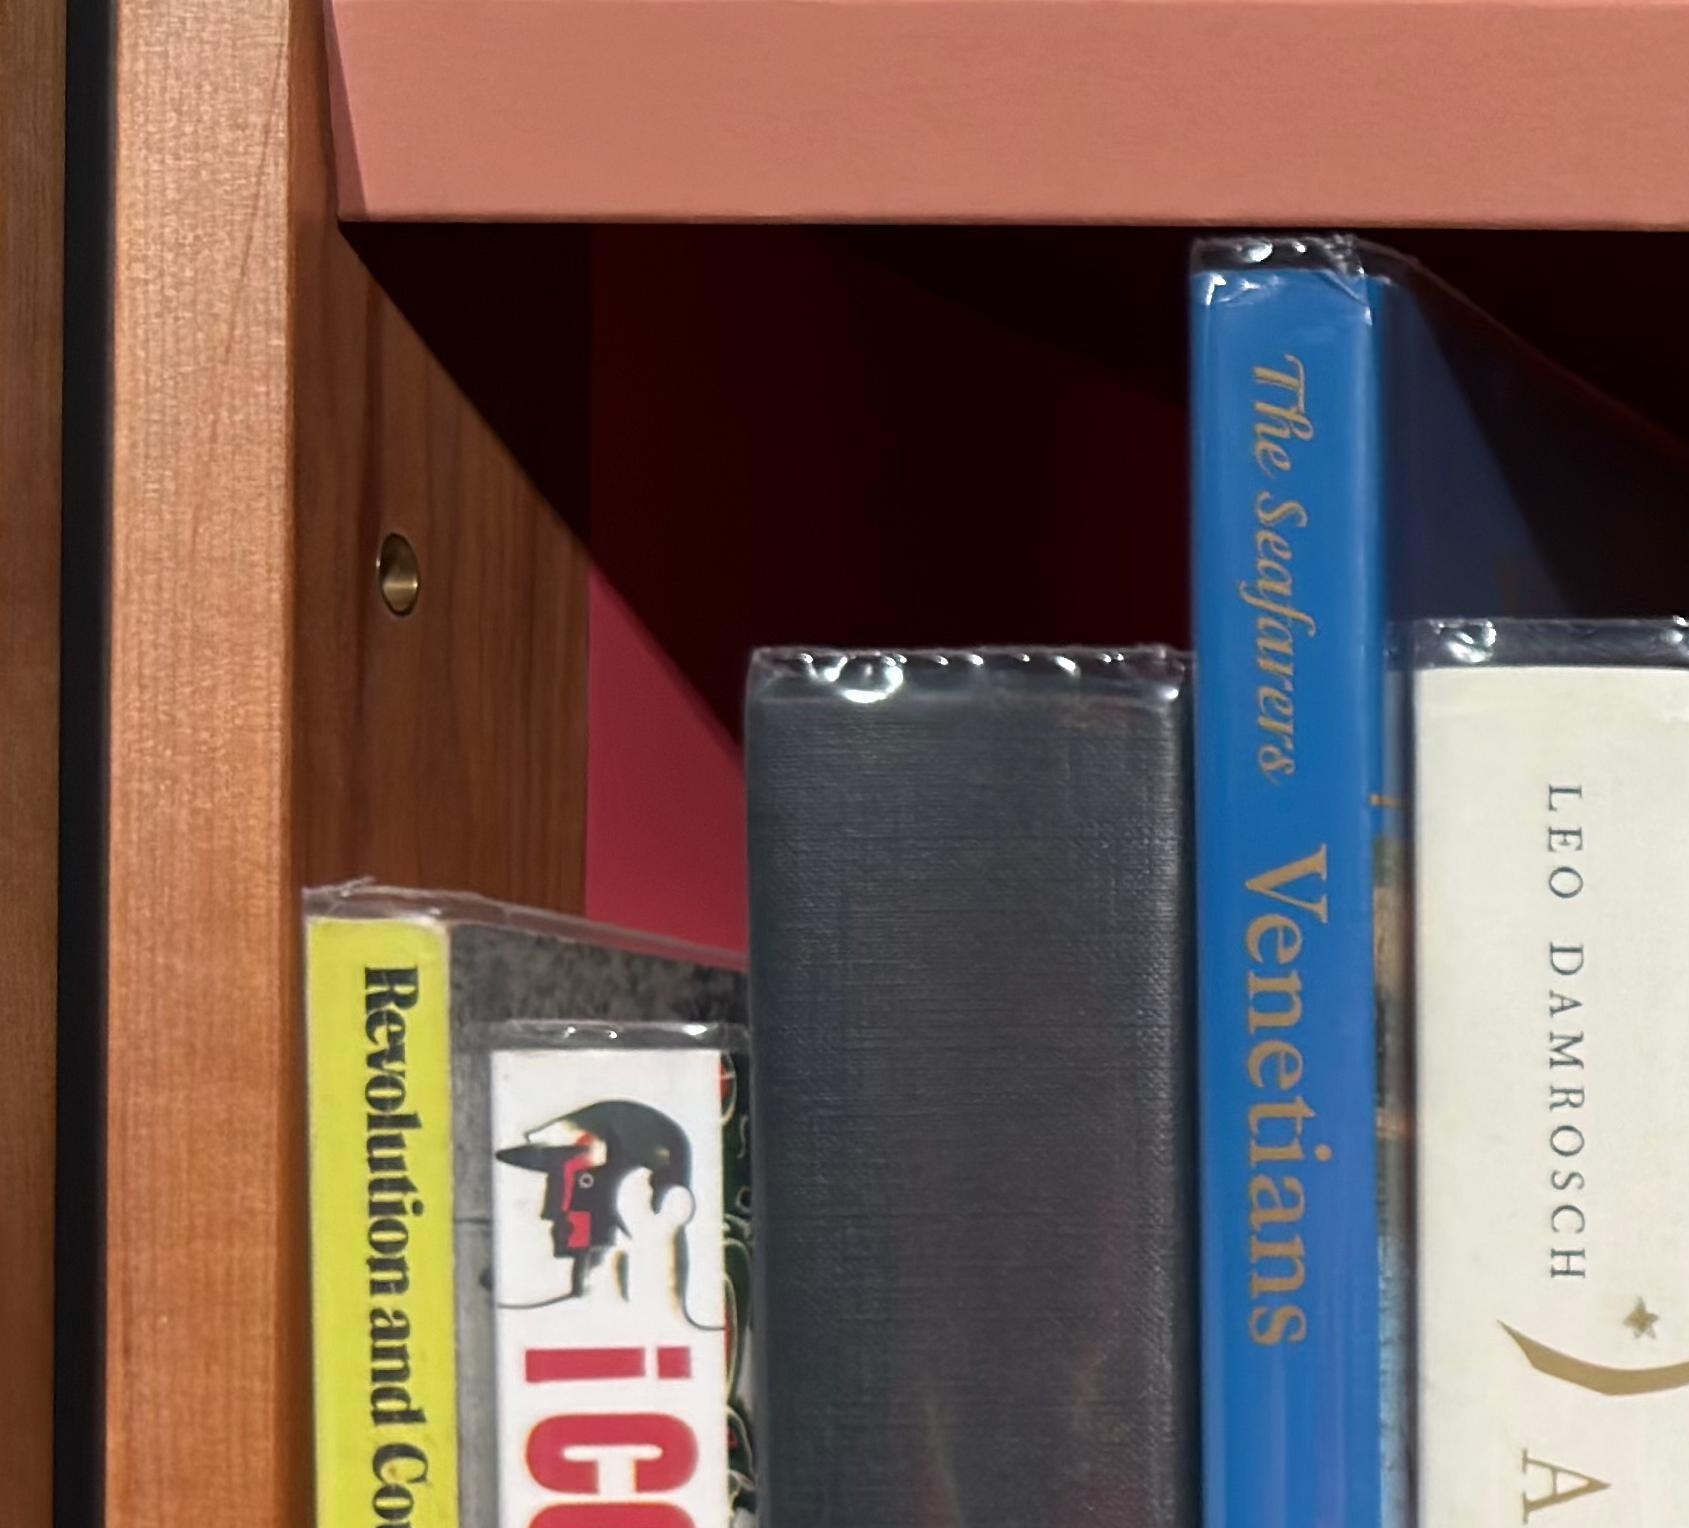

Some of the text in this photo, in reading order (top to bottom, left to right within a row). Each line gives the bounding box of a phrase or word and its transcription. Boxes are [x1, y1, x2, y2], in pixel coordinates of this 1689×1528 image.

[1239, 353, 1317, 786] The Seafarers
[364, 966, 424, 1296] Revolution
[1245, 842, 1331, 1346] Venetians
[1548, 784, 1585, 1277] LEO DAMROSCH
[369, 1307, 428, 1425] and
